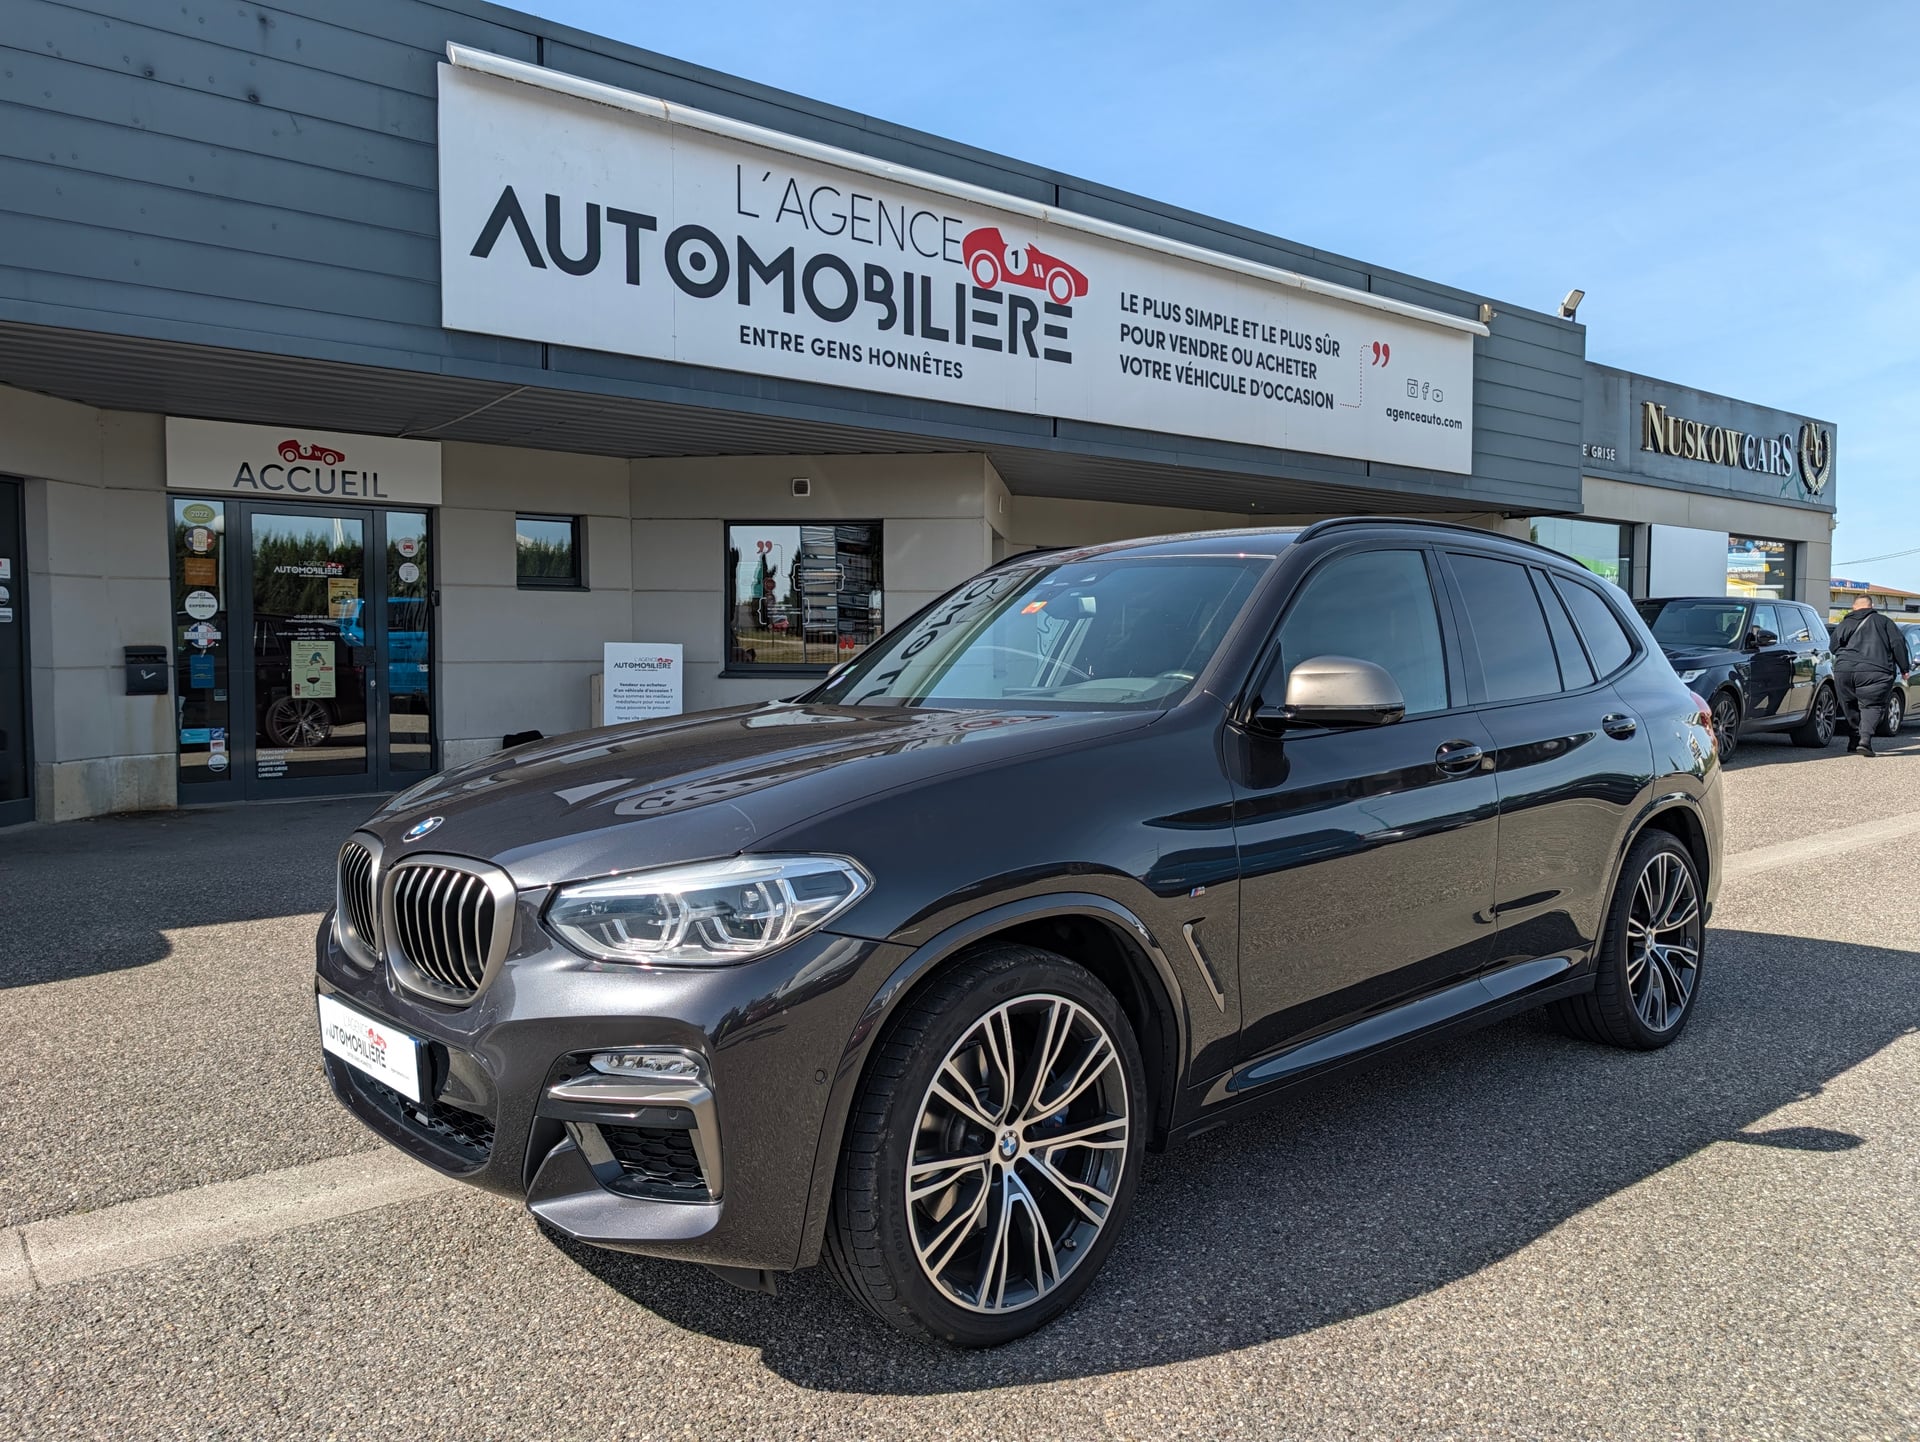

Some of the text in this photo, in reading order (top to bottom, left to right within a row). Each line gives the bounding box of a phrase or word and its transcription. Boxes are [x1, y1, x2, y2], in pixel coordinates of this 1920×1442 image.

[737, 164, 963, 264] L'AGENCE
[1011, 250, 1019, 269] 1
[740, 325, 963, 379] ENTRE GENS HONNÊTES
[1120, 292, 1340, 358] LE PLUS SIMPLE ET LE PLUS SÛR
[1120, 323, 1317, 380] POUR VENDRE OU ACHETER
[1119, 354, 1334, 410] VOTRE VÉHICULE D'OCCASION
[1386, 406, 1463, 430] agenceauto.com
[233, 462, 388, 498] ACCUEIL
[1591, 445, 1616, 461] GRISE
